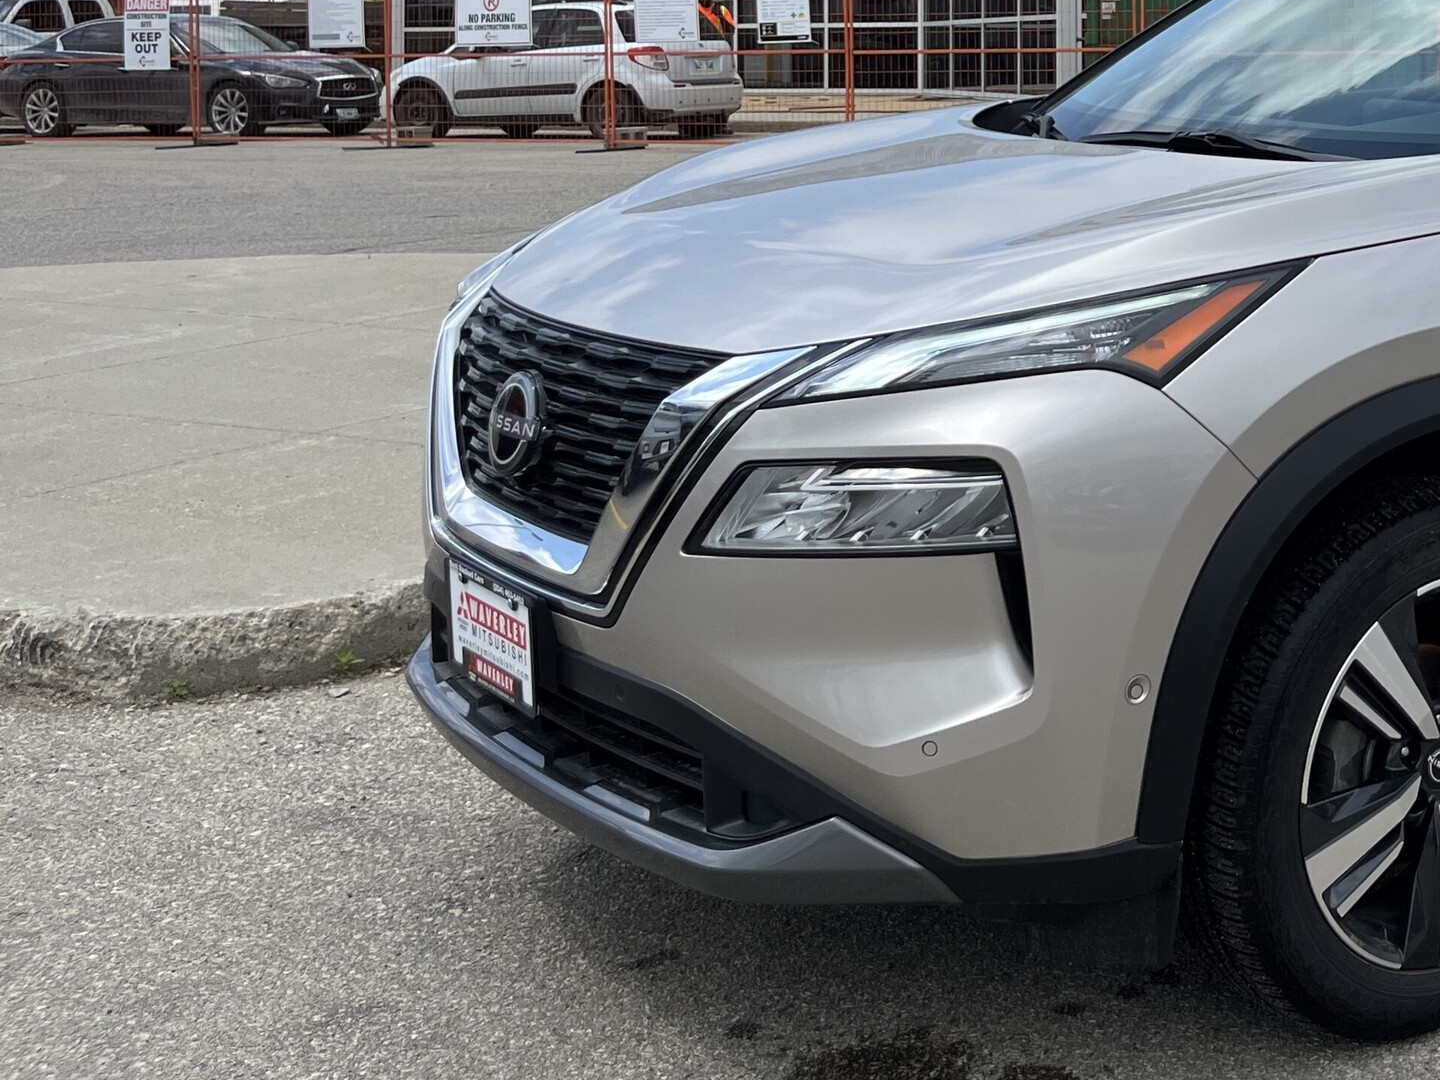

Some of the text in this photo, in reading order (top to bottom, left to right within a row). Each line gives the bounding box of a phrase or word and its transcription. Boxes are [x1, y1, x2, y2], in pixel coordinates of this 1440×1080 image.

[468, 13, 516, 23] NO PARKING
[131, 32, 162, 42] KEEP
[135, 44, 159, 54] OUT
[469, 597, 527, 648] WAVERLEY
[471, 623, 527, 666] MITSUBISHI
[476, 658, 514, 692] WAVERLEY
